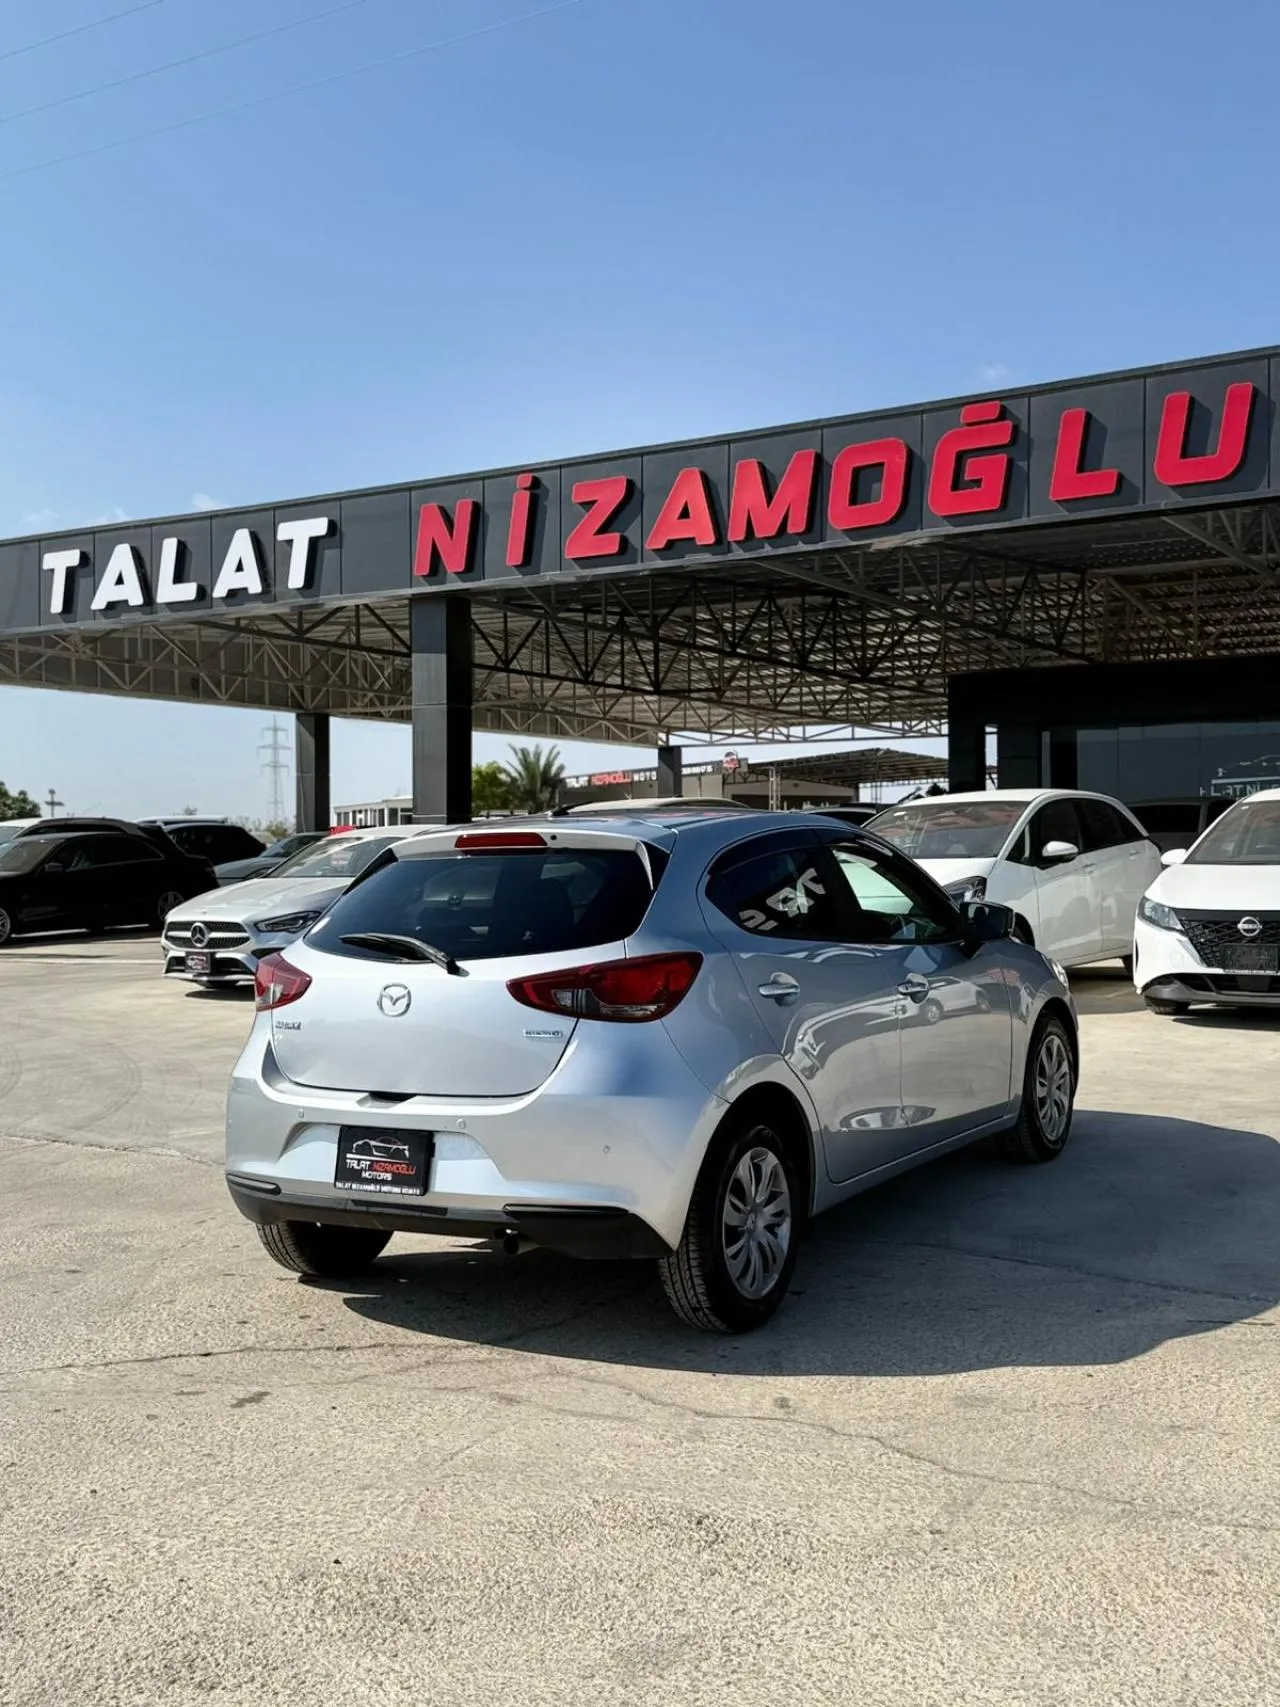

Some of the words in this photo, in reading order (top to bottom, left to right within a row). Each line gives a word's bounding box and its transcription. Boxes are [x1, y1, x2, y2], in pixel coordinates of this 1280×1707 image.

[41, 516, 330, 615] TALAT
[415, 382, 1255, 577] NİZAMOĞLU
[346, 1159, 371, 1170] TALAT
[361, 1171, 392, 1181] MOTORS
